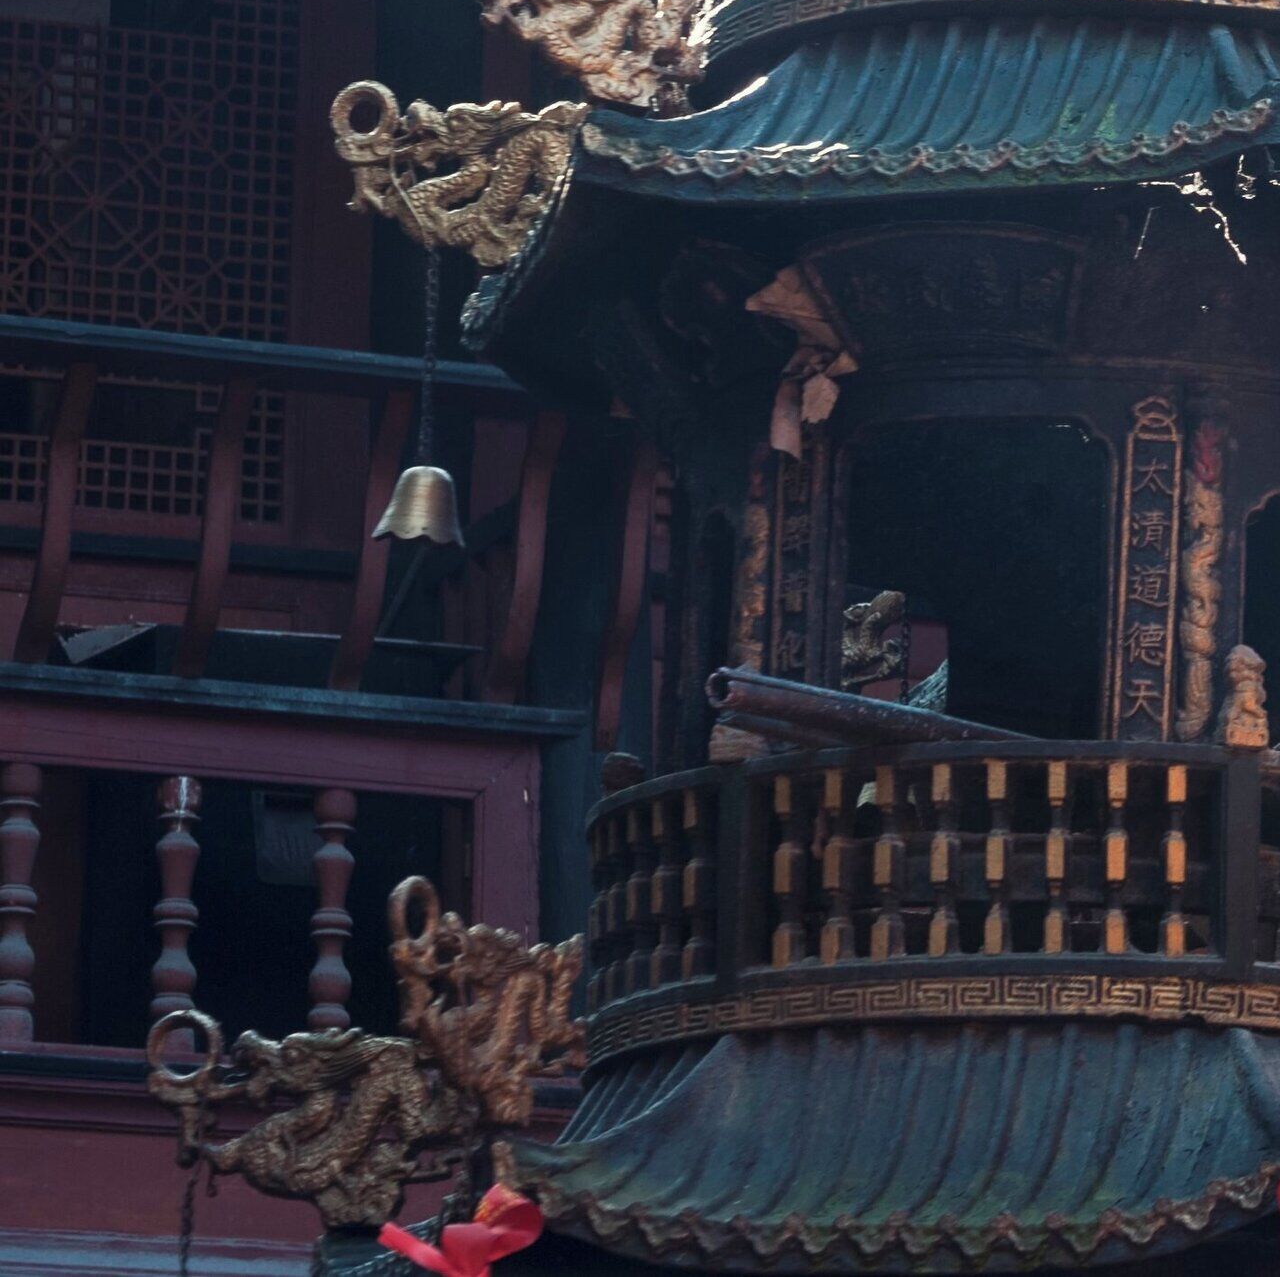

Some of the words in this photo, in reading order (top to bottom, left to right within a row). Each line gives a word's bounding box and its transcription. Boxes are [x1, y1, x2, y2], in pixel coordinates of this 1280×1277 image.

[1122, 456, 1173, 740] 太清道德天
